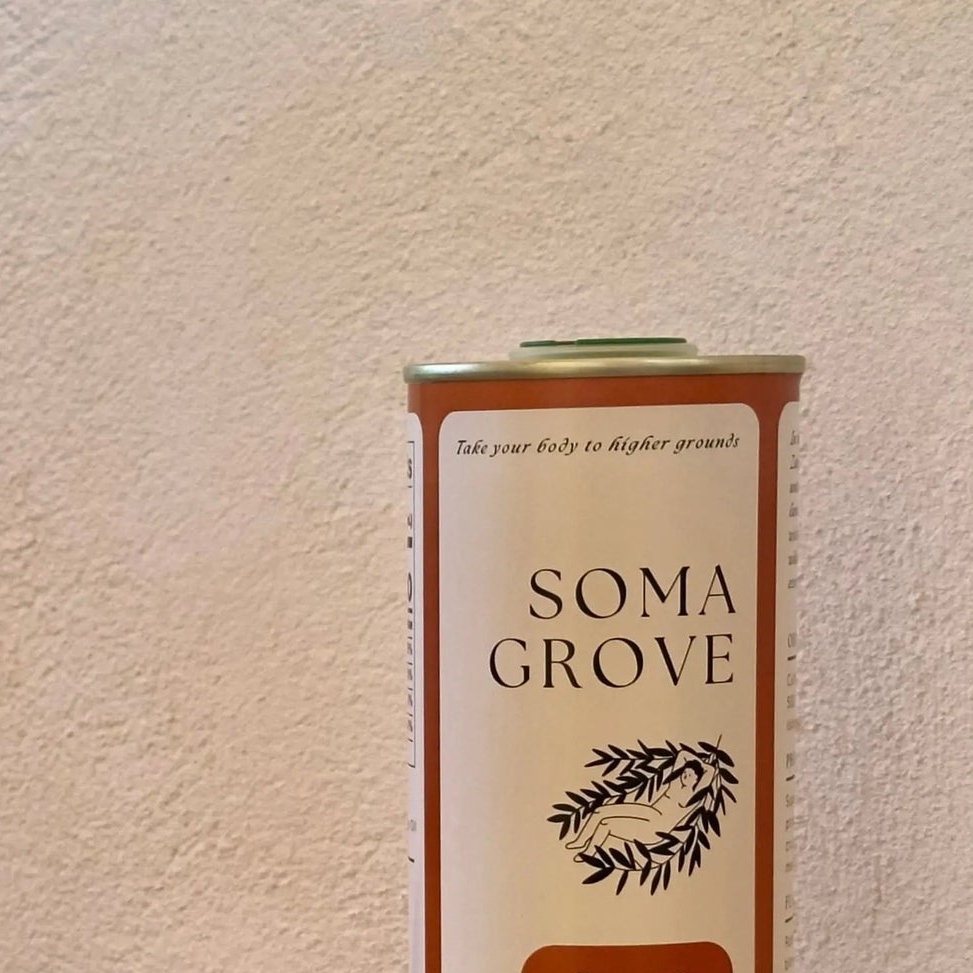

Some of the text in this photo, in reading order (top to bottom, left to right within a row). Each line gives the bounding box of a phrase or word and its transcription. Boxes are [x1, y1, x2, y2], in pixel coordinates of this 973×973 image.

[456, 432, 740, 458] Take your body to higher grounds
[529, 563, 737, 620] SOMA
[489, 633, 734, 689] GROVE
